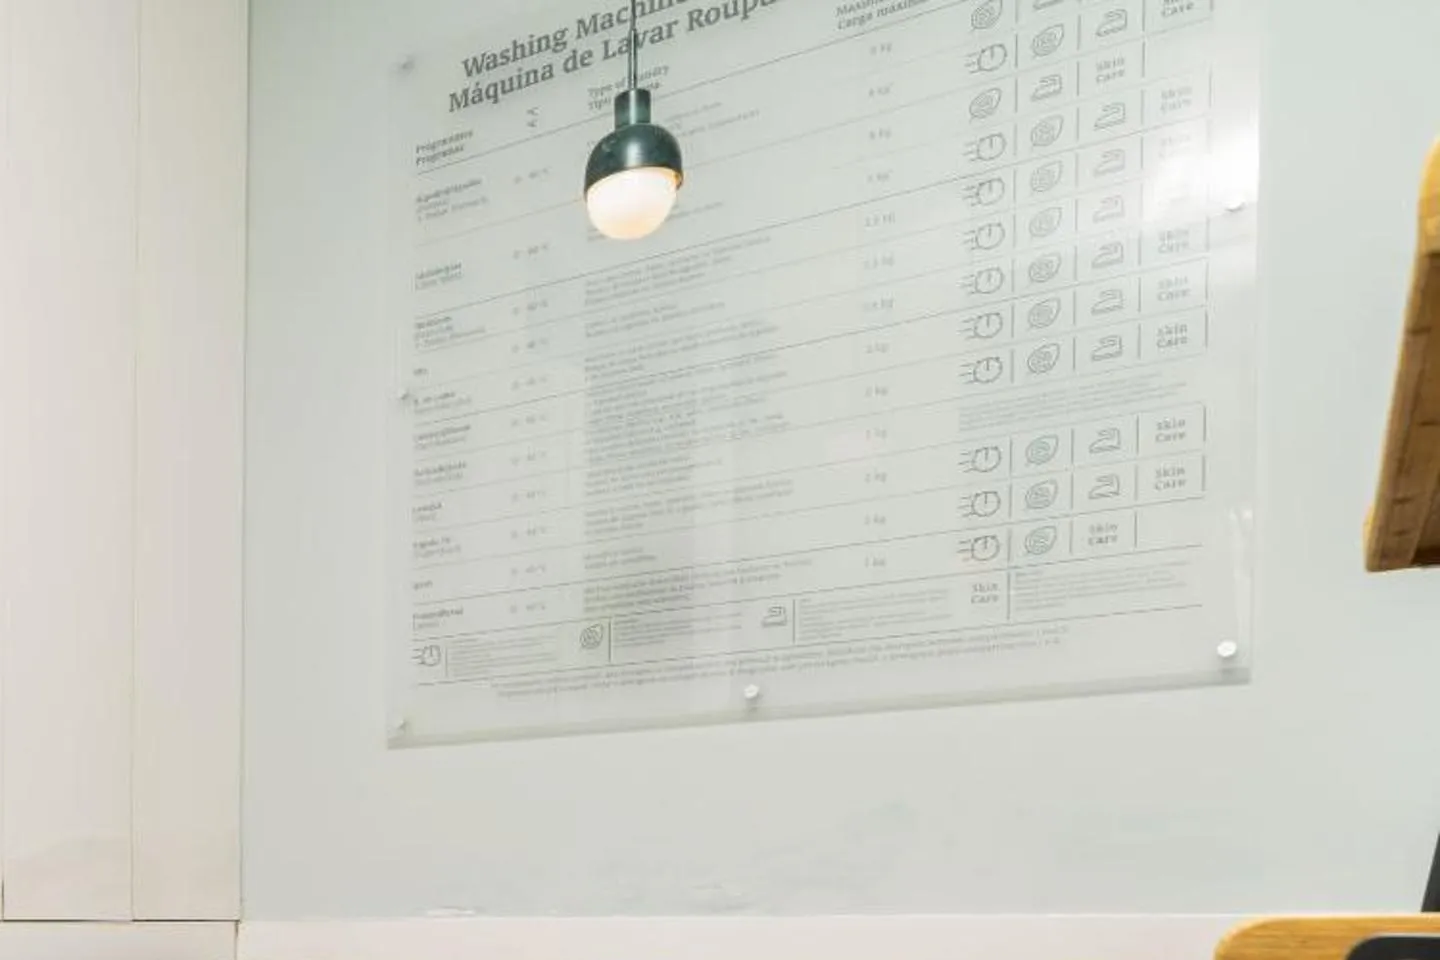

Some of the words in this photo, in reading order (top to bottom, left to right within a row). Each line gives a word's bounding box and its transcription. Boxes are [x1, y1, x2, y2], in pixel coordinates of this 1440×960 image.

[449, 65, 554, 112] Máquina
[562, 47, 594, 74] de
[603, 20, 679, 60] Lavar
[462, 27, 569, 78] Washing
